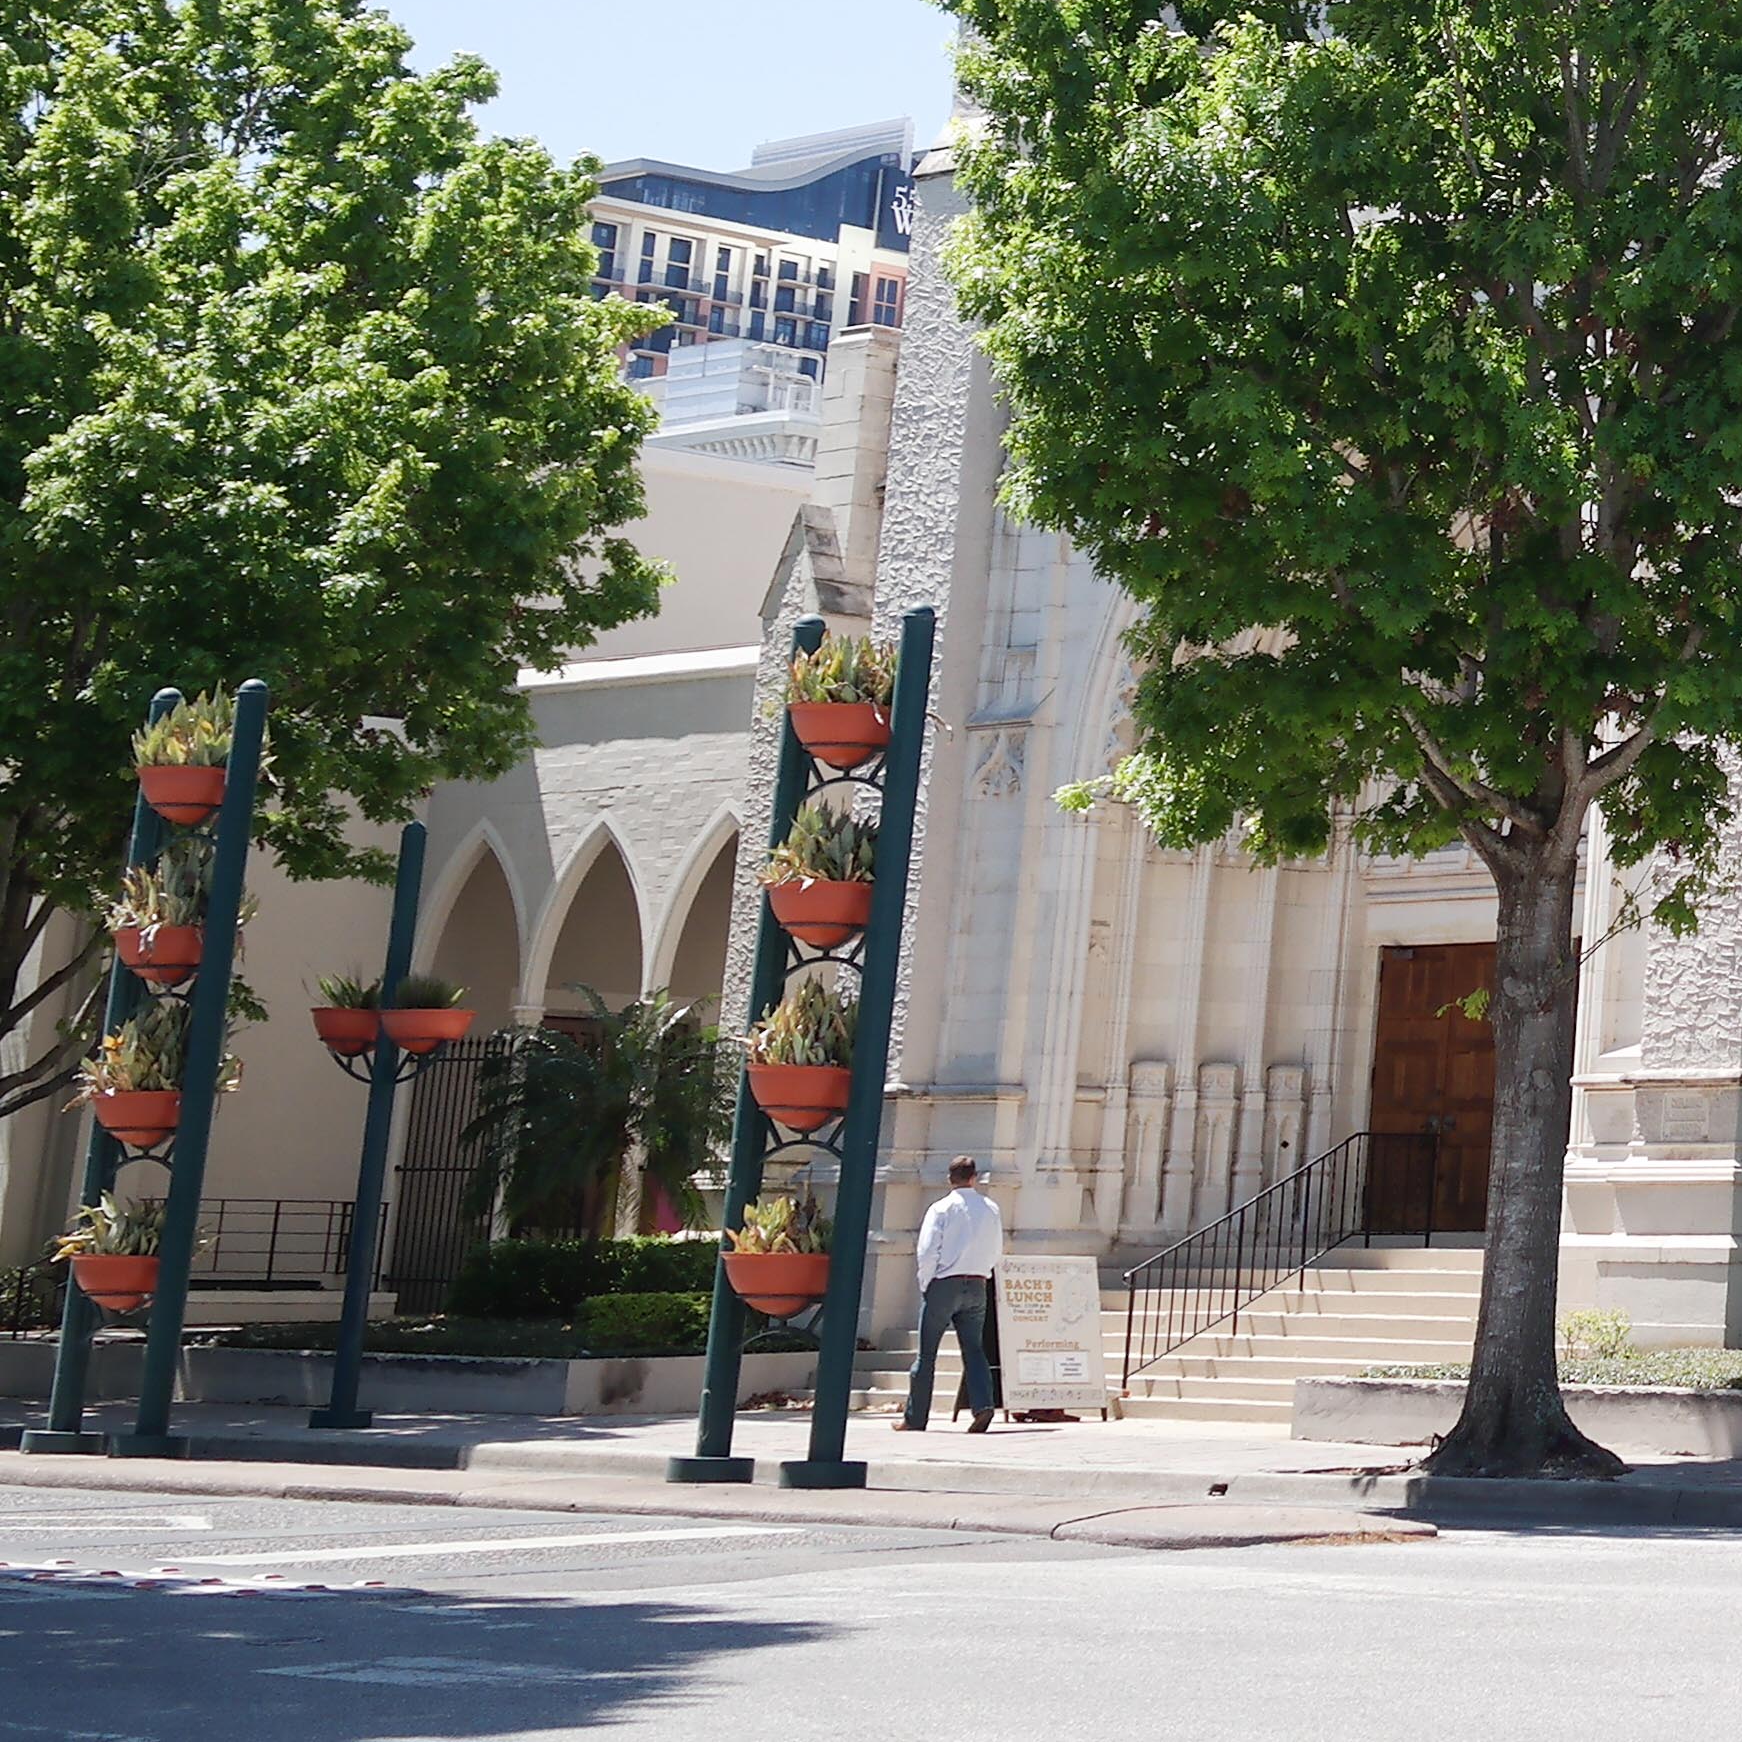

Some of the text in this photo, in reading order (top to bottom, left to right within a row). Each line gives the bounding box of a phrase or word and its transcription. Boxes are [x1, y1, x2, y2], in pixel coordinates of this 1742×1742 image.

[1004, 1278, 1053, 1291] BACH'S
[1006, 1291, 1053, 1303] LUNCH
[1025, 1338, 1080, 1350] Performing
